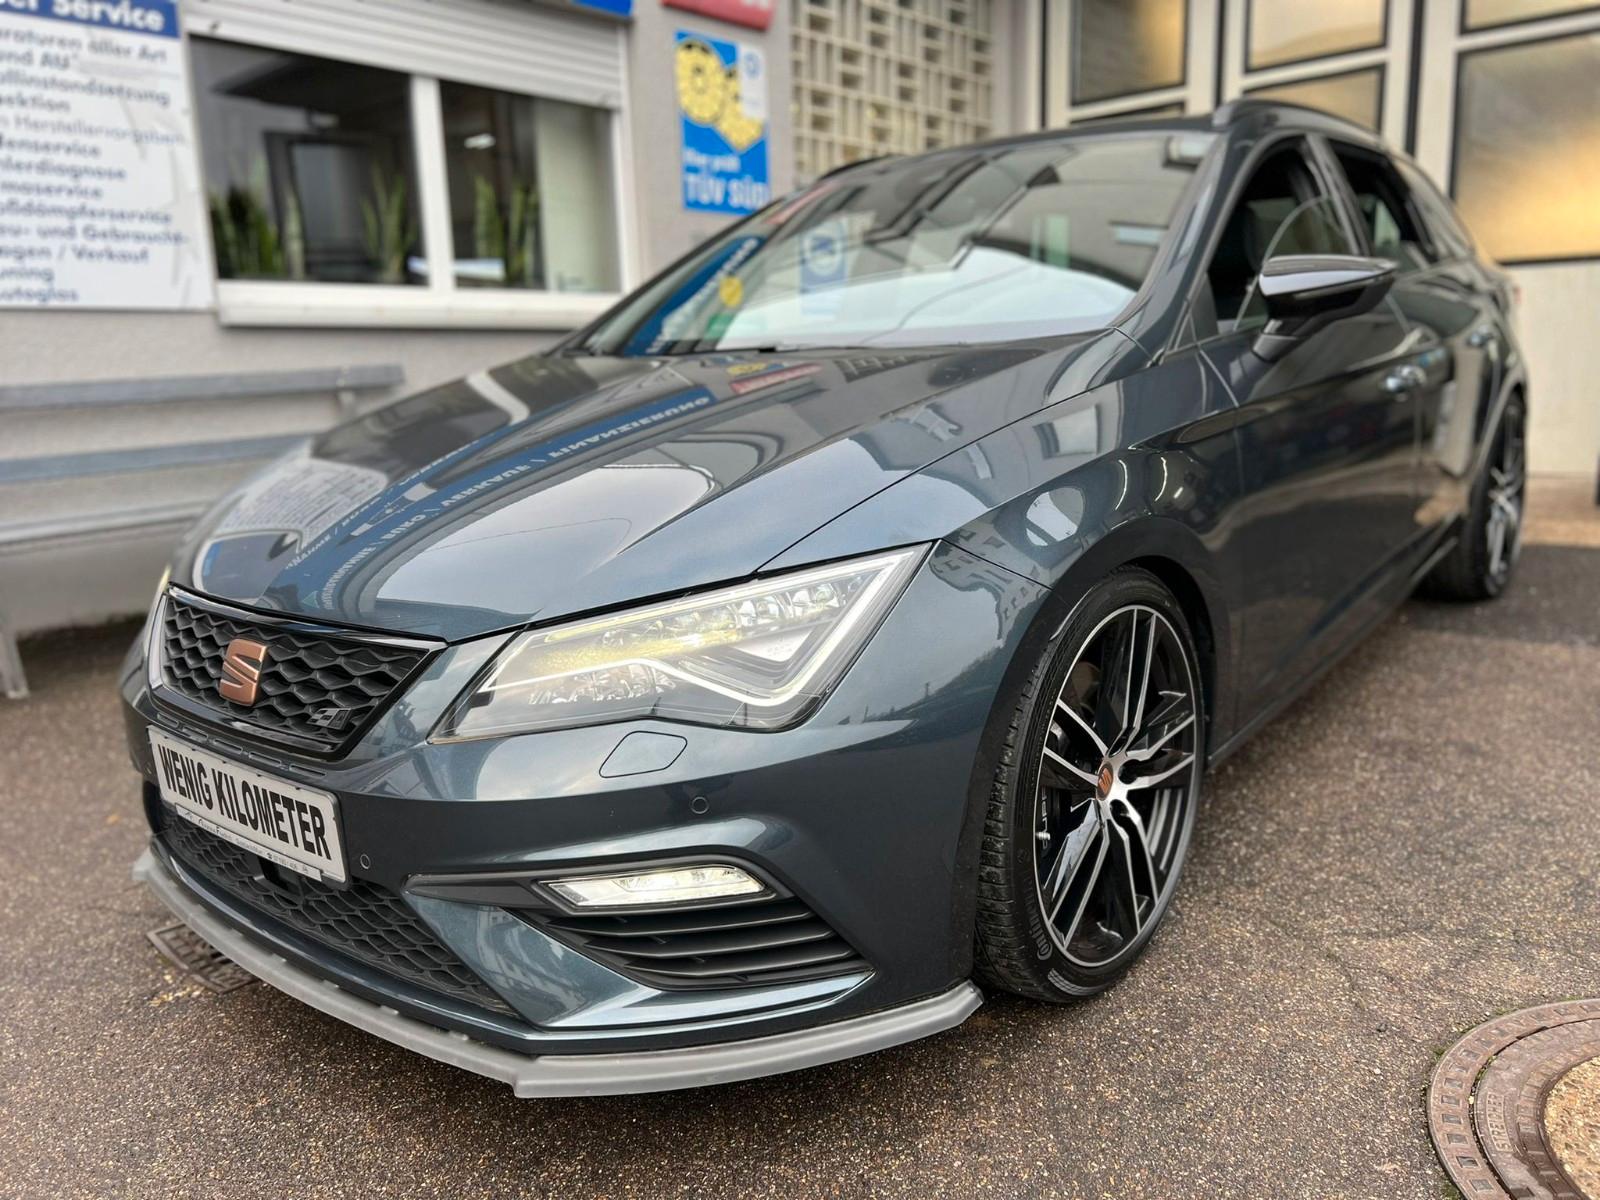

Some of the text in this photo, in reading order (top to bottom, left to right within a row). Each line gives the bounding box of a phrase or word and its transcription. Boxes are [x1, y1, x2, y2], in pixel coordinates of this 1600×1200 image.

[54, 0, 165, 31] Service
[72, 247, 149, 265] Verkauf
[157, 743, 214, 811] WENIG
[210, 767, 333, 861] KILOMETER
